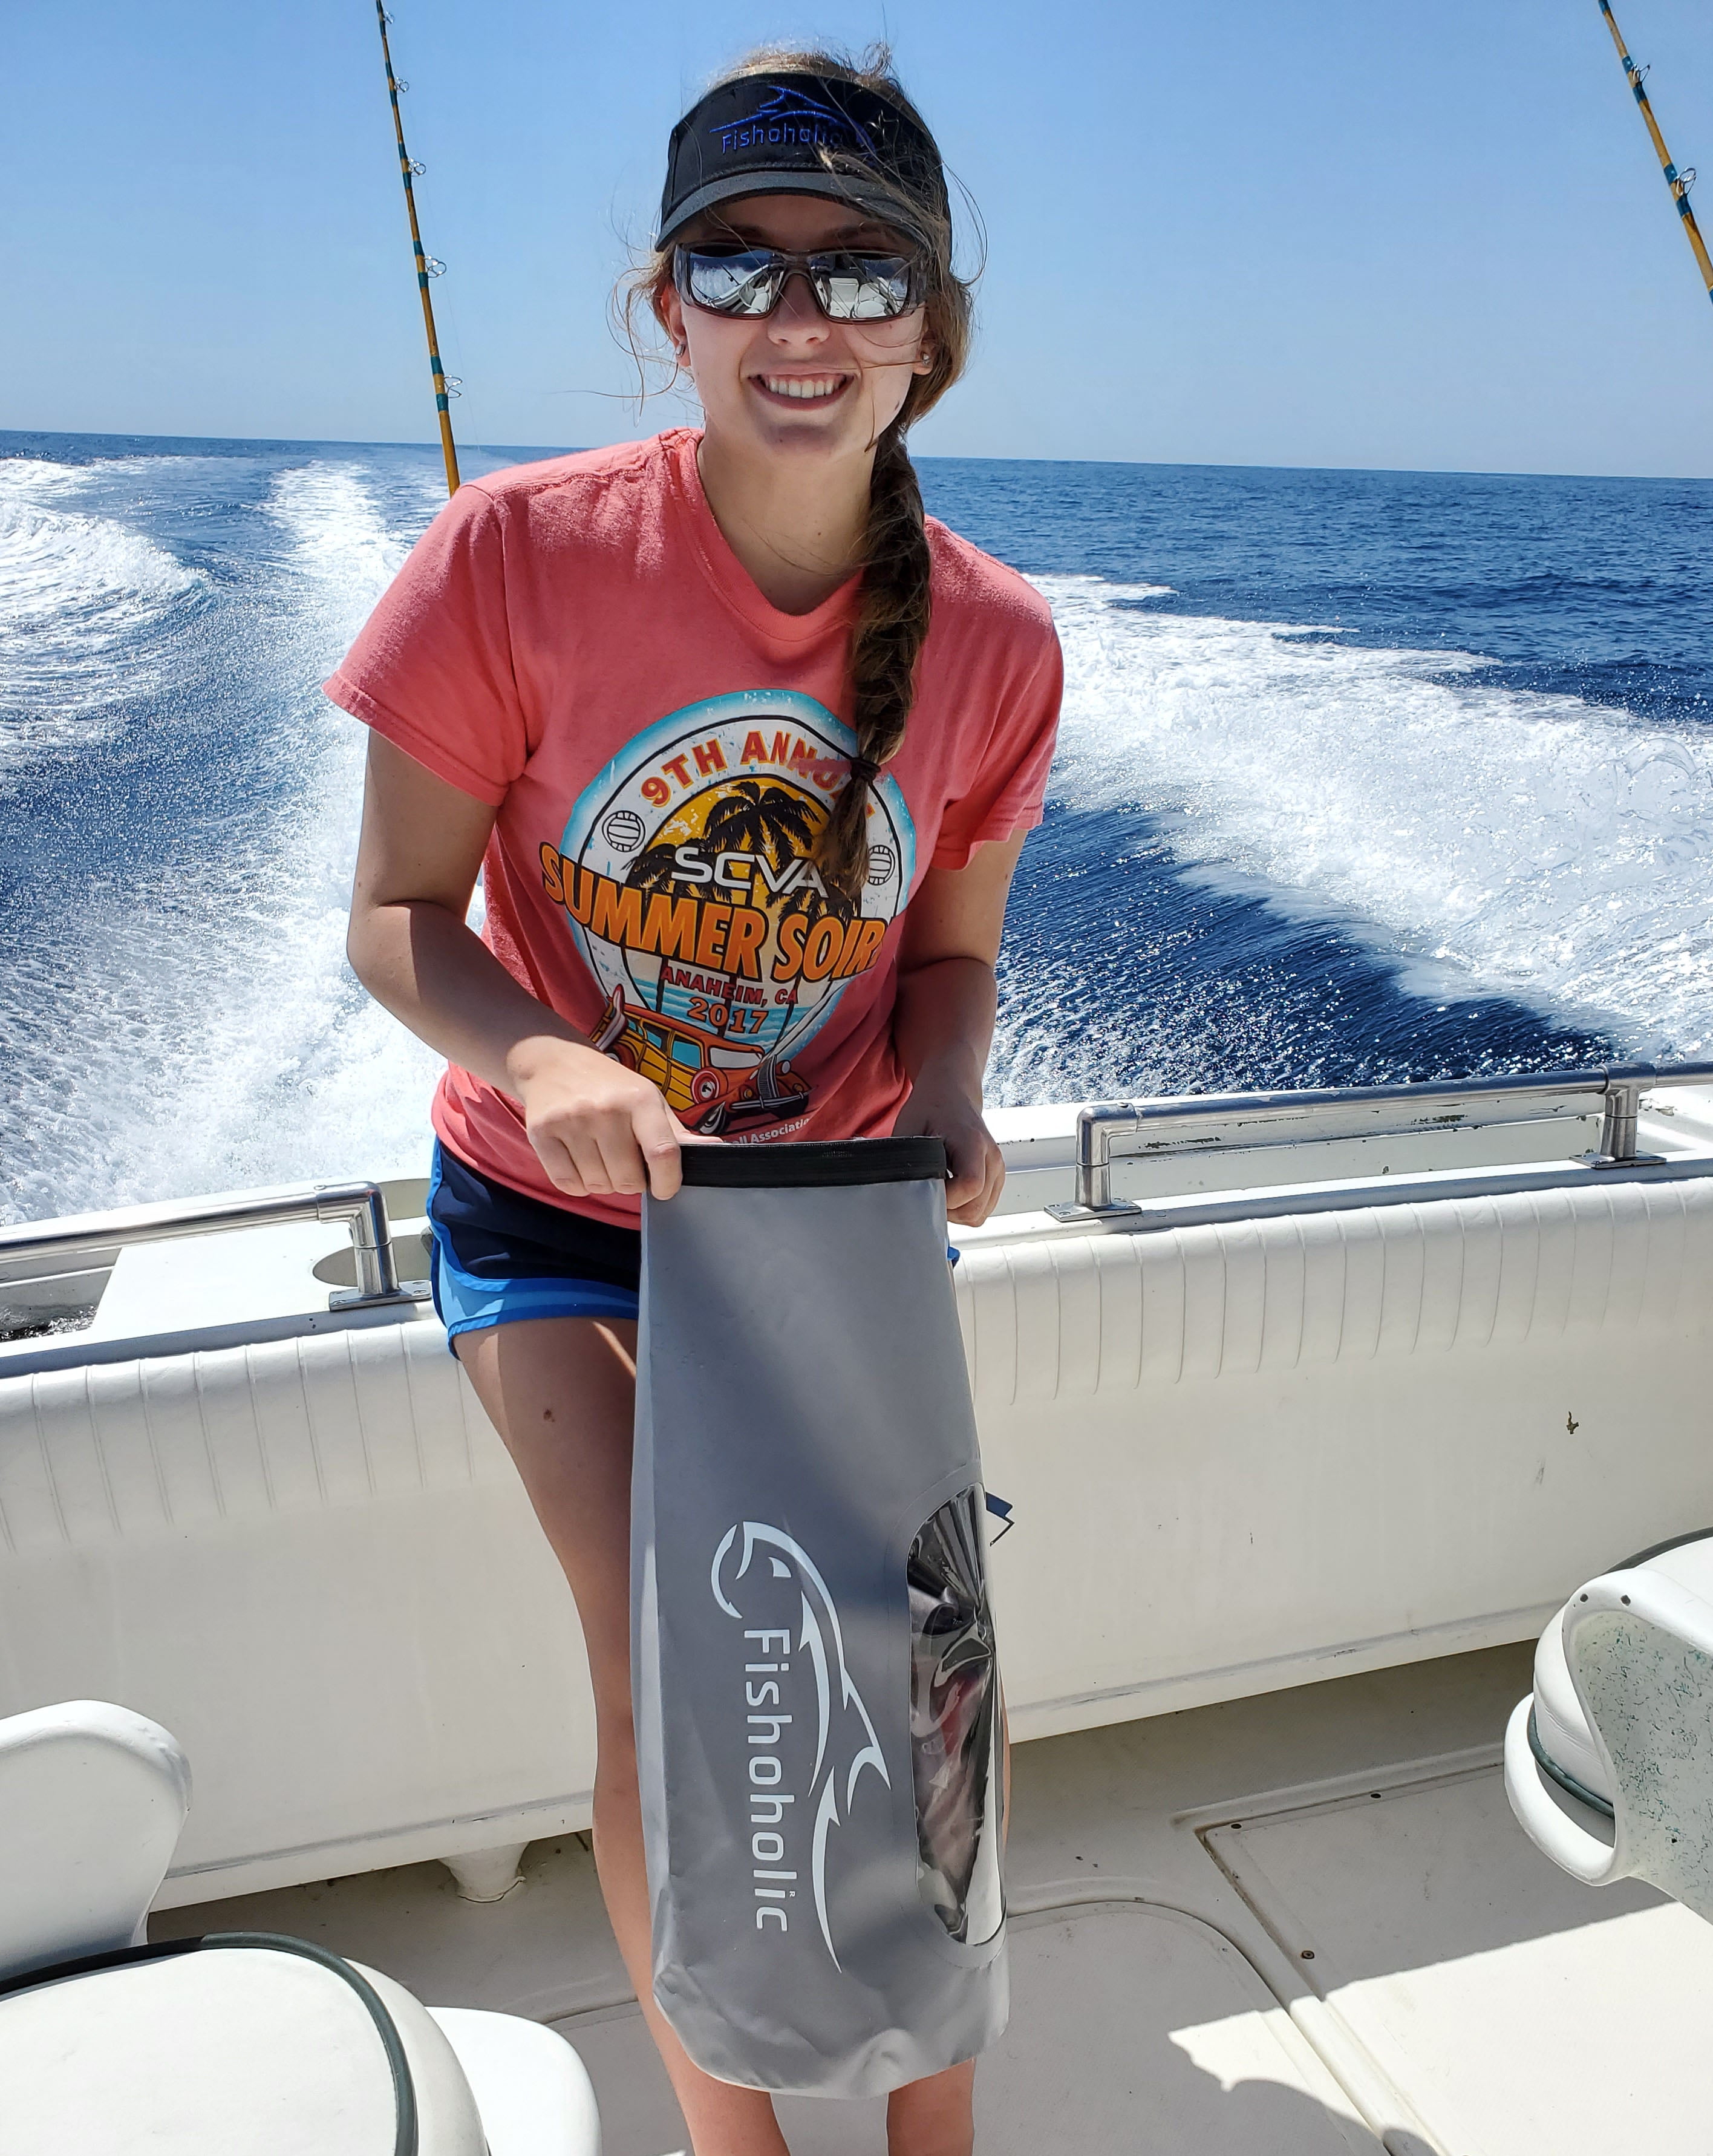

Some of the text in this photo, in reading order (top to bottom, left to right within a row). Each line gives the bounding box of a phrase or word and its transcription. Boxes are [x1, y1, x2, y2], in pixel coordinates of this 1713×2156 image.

[641, 731, 875, 818] 9TH ANNU
[671, 848, 828, 898] SCVA
[540, 844, 884, 982] SUMMER SOIR
[661, 966, 798, 1008] ANAHEIM, CA
[688, 998, 769, 1034] 2017
[750, 1119, 810, 1143] Associatio
[745, 1630, 797, 1932] Fishoholic
